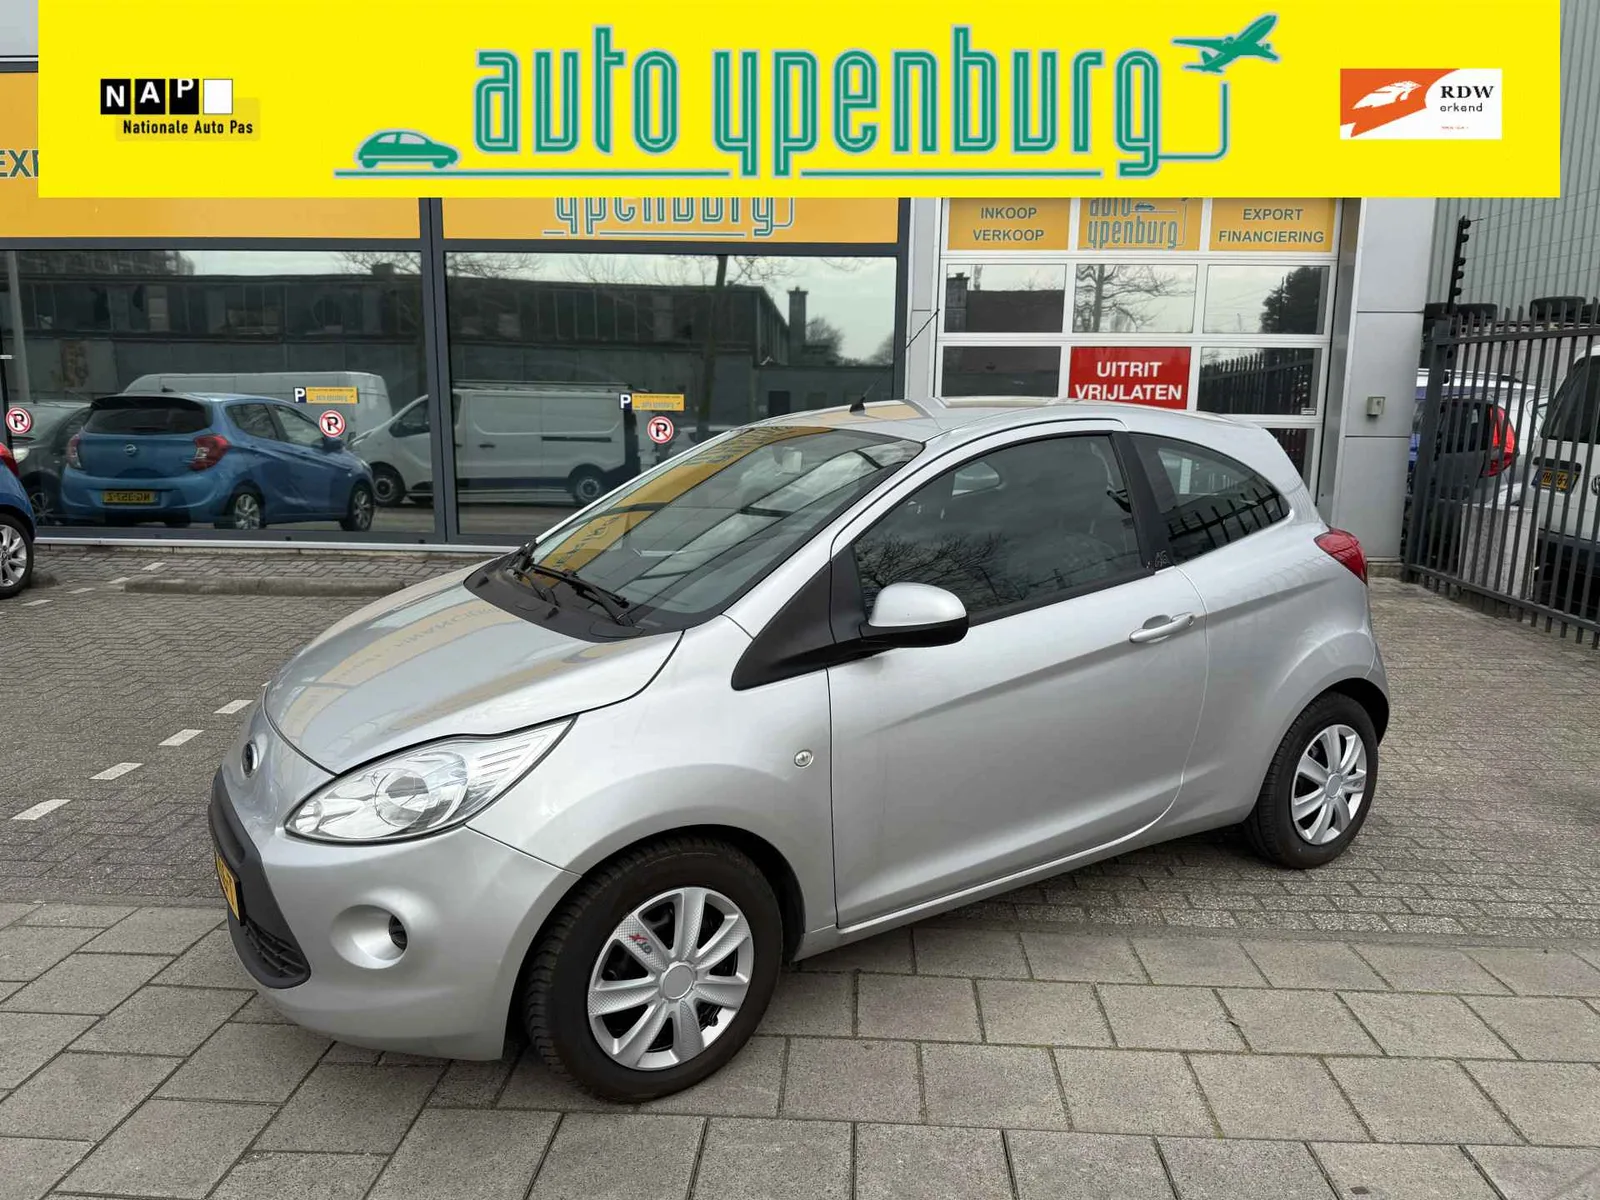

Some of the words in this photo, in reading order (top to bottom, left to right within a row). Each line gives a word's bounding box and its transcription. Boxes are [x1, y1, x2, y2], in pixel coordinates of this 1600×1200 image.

[980, 207, 1037, 219] INKOOP
[1243, 208, 1303, 221] EXPORT
[973, 229, 1045, 241] VERKOOP
[1087, 216, 1178, 249] ypenburg
[1219, 230, 1324, 243] FINANCIERING
[1096, 361, 1162, 378] UITRIT
[1074, 383, 1183, 401] VRIJLATEN
